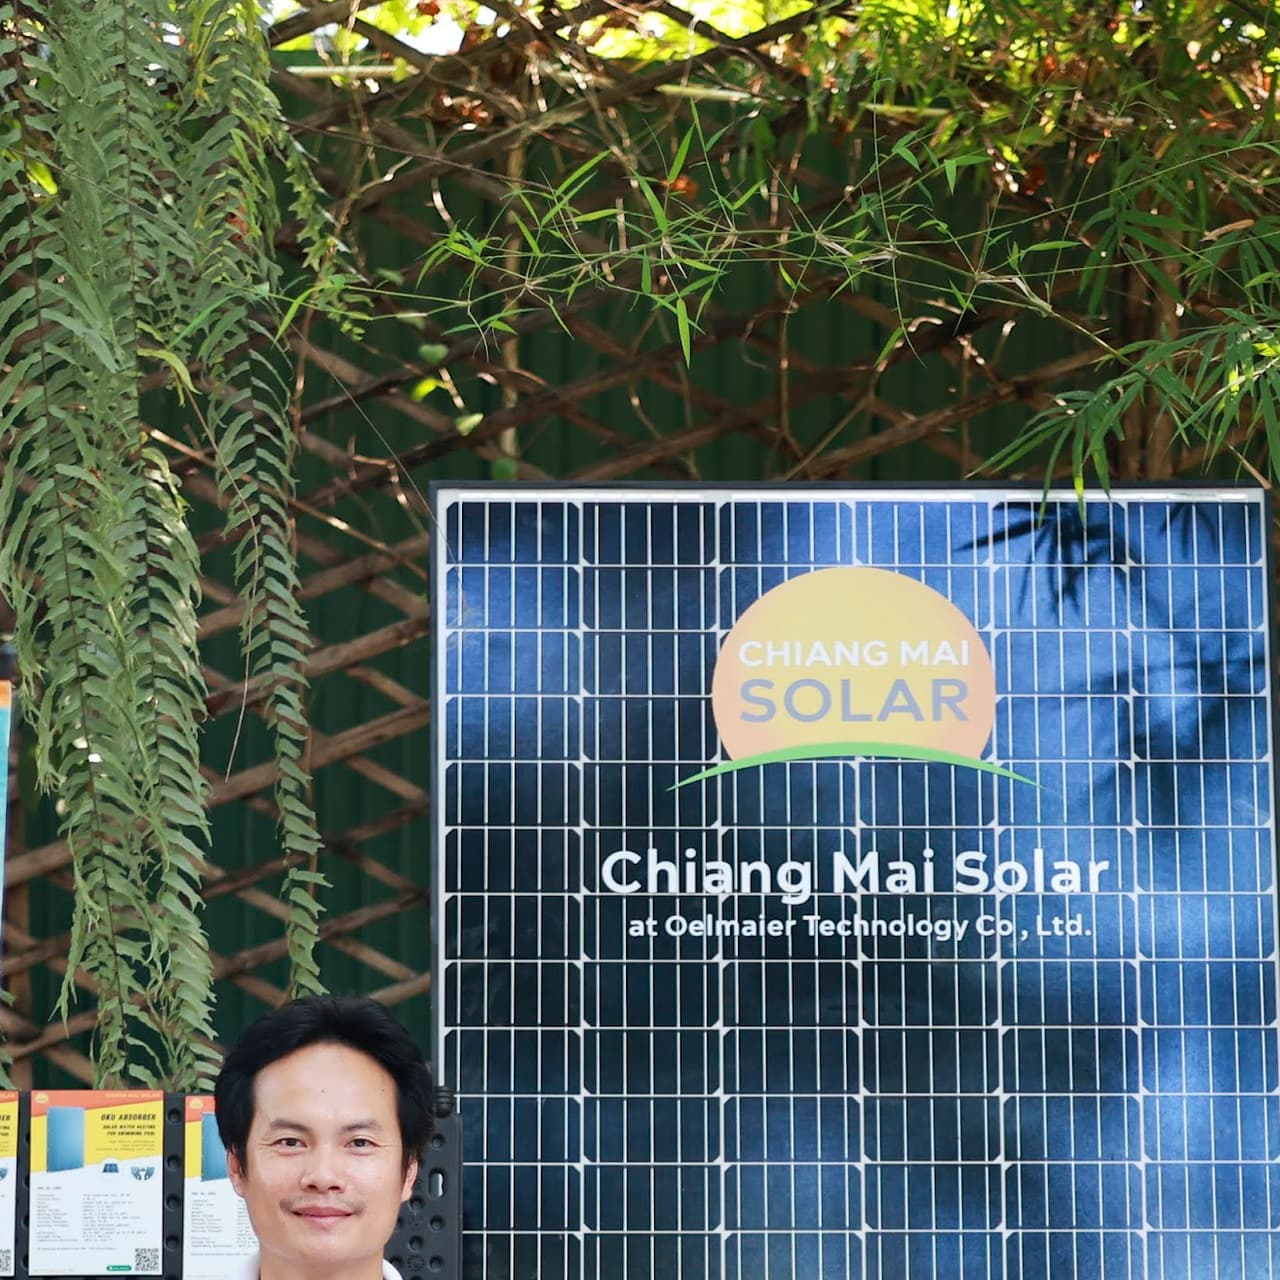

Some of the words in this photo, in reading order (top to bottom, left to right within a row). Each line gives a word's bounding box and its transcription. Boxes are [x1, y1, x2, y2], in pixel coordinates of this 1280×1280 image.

[738, 639, 889, 667] CHIANG
[900, 639, 969, 666] MAI
[739, 677, 969, 724] SOLAR
[601, 848, 811, 905] Chiang
[833, 848, 935, 894] Mai
[955, 848, 1110, 894] Solar
[628, 916, 658, 937] at
[665, 914, 797, 937] Oelmaier
[803, 914, 968, 942] Technology
[1036, 913, 1092, 937] Ltd.
